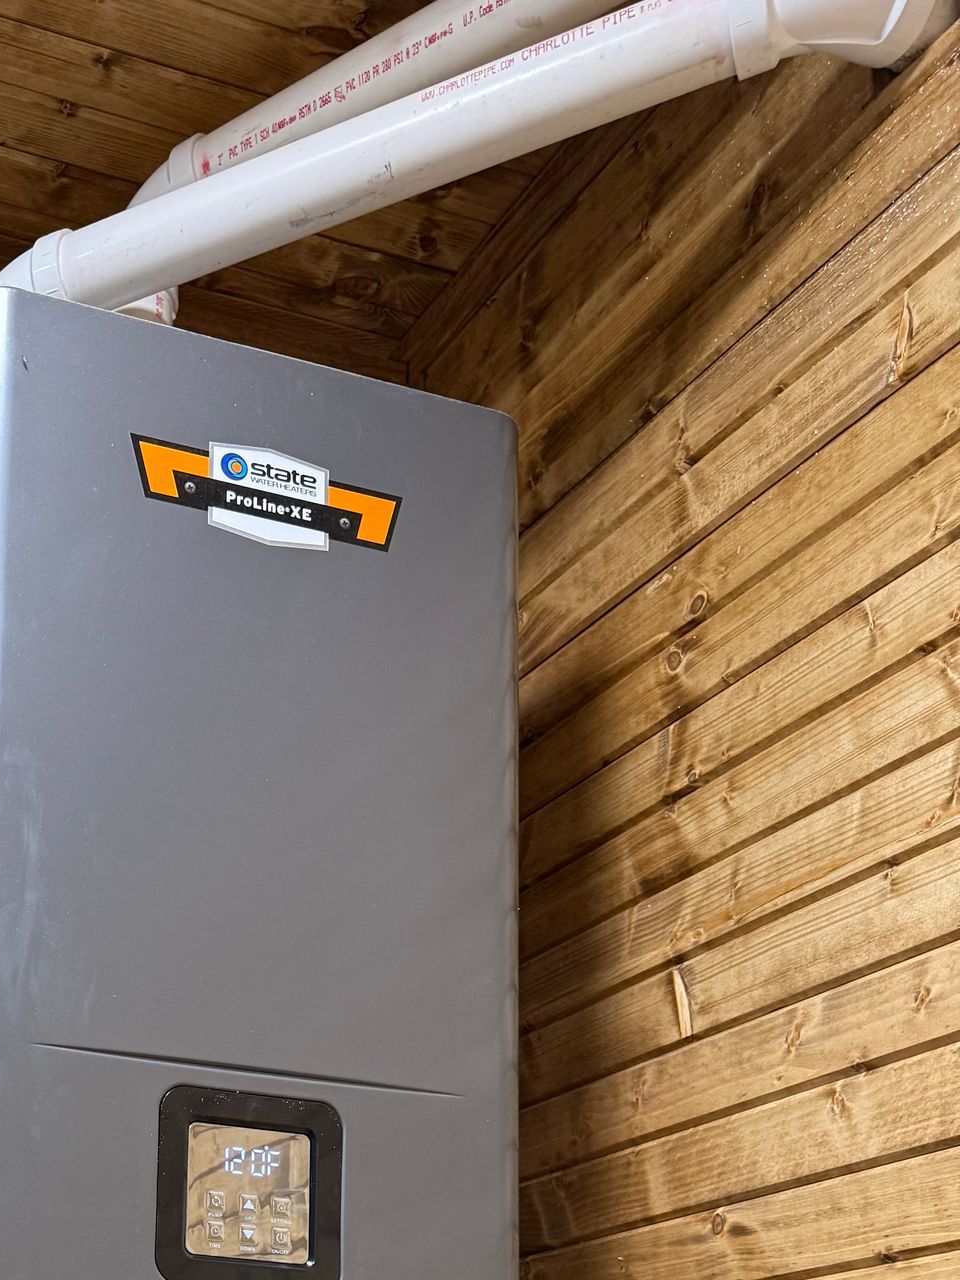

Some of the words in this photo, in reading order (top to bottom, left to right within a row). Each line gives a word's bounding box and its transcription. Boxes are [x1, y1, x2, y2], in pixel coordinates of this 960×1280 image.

[228, 145, 238, 159] PVC
[240, 136, 253, 152] TYPE
[260, 127, 271, 142] SCH
[298, 102, 312, 120] ASTM
[346, 78, 356, 93] PVC
[358, 70, 371, 86] 1120
[372, 64, 380, 79] PR
[382, 57, 391, 73] 280
[393, 50, 404, 66] PSI
[479, 3, 494, 18] Code
[420, 57, 515, 102] WWW.CHARLOTTEPIPE.COM
[521, 24, 594, 62] CHARLOTTE
[602, 7, 637, 30] PIPE
[251, 462, 317, 490] state
[251, 476, 279, 490] WATER
[279, 483, 317, 497] HEATERS
